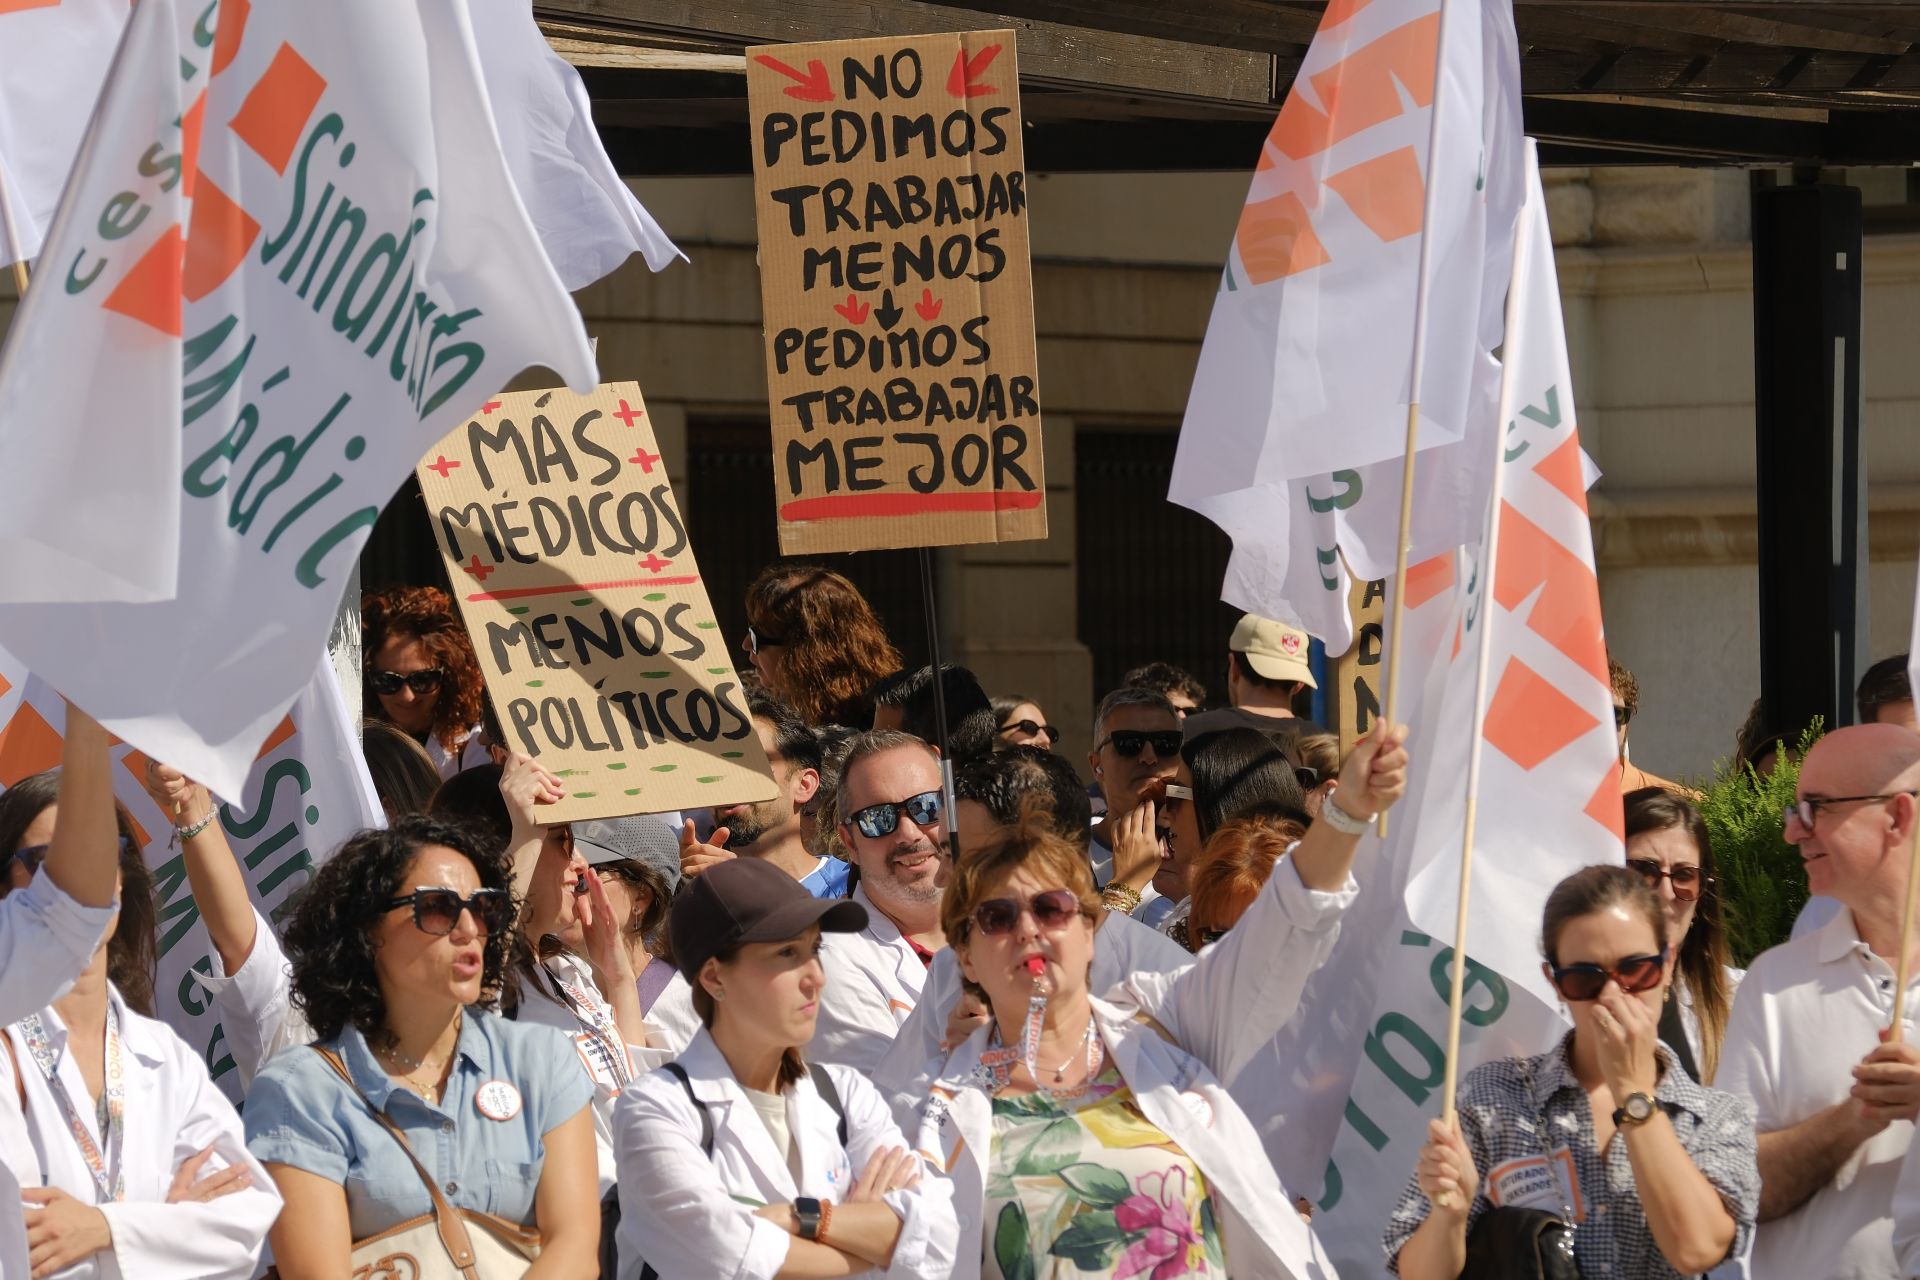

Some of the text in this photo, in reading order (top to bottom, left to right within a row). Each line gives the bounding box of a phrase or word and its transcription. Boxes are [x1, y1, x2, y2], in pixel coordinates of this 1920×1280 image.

[843, 48, 923, 99] NO
[763, 106, 1011, 168] PEDIMOS
[771, 171, 1026, 236] TRABAJAR
[803, 228, 1006, 291] MENOS
[774, 316, 990, 376] PEDIMOS
[782, 376, 1039, 433] TRABAJAR
[467, 392, 620, 491] MÁS
[786, 424, 1037, 496] MEJOR
[440, 484, 687, 564] MÉDICOS
[485, 602, 706, 676] MENOS
[507, 676, 752, 758] POLÍTICOS
